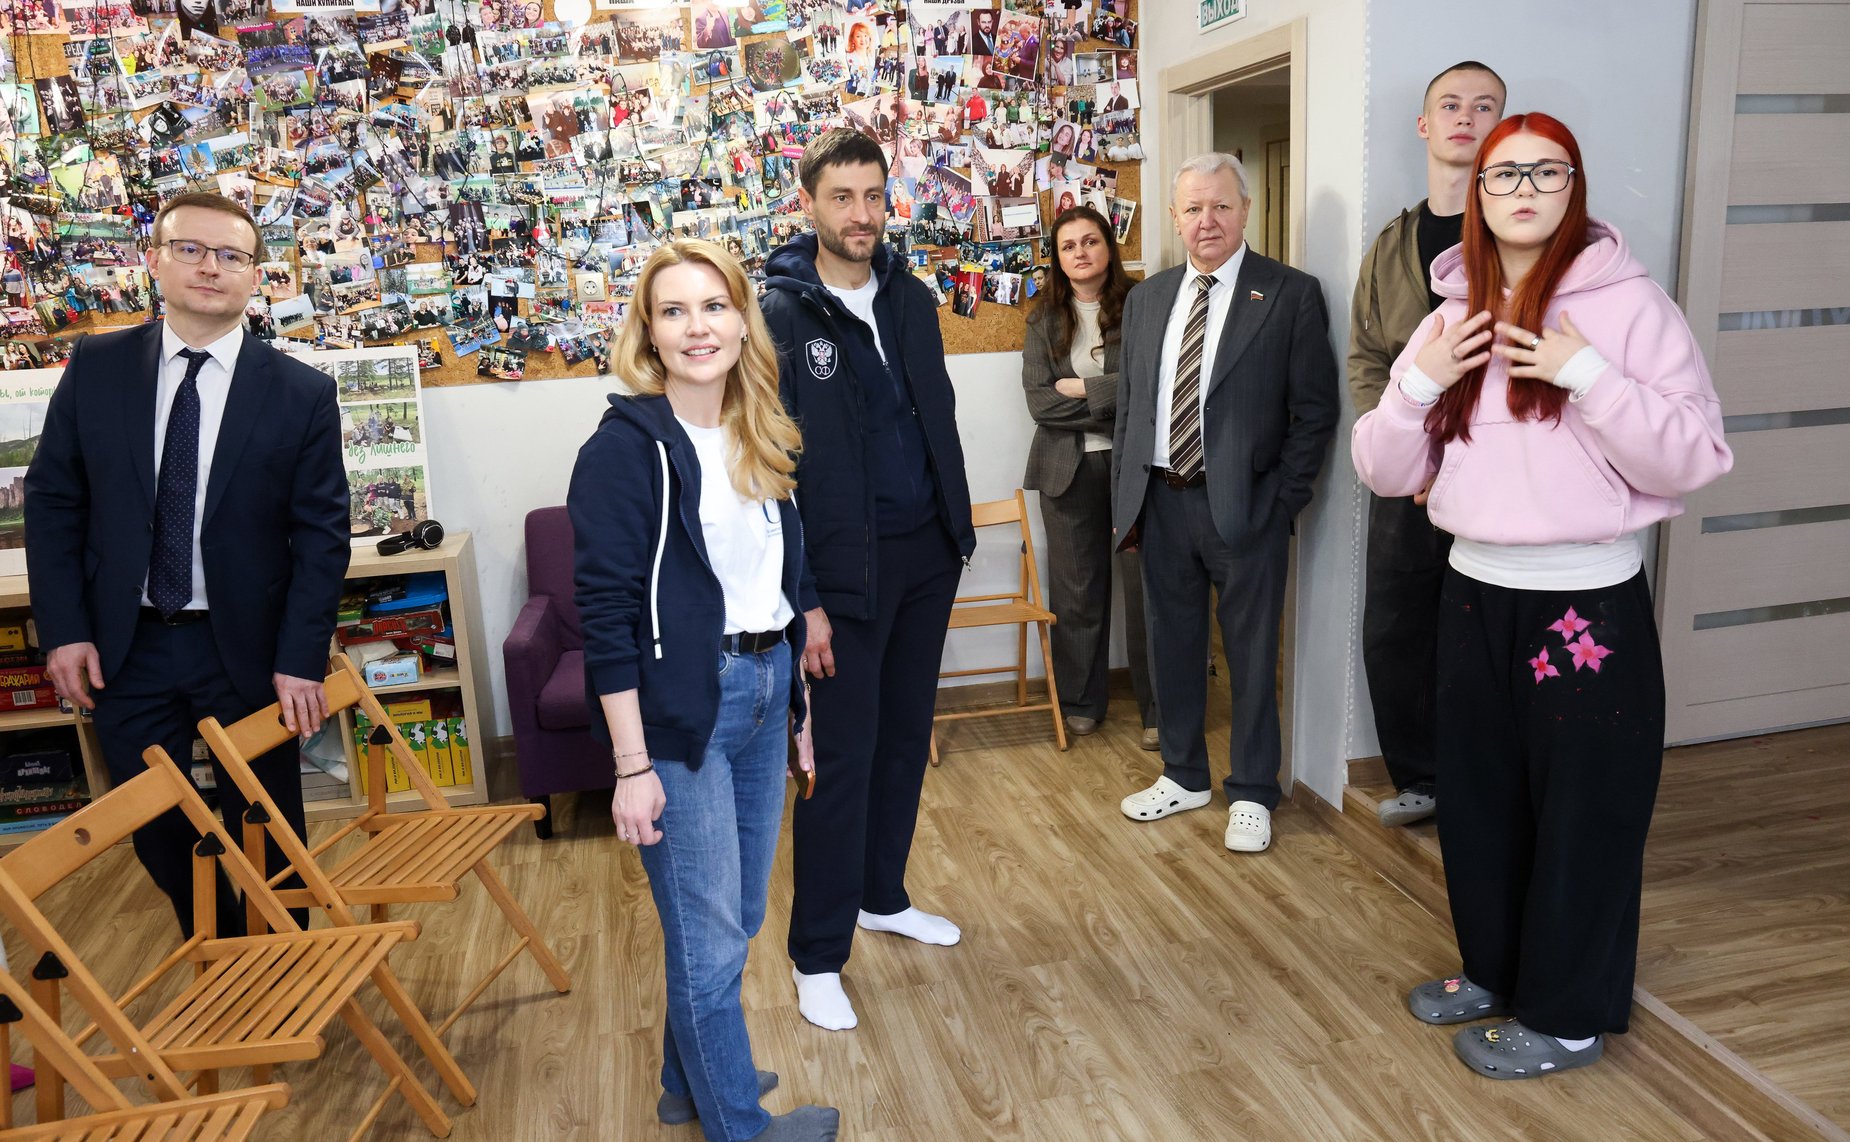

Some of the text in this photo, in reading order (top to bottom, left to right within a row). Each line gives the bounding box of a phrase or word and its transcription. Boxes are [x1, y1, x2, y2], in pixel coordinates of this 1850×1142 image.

[1202, 0, 1239, 25] ВЫХОД
[348, 440, 416, 464] без лишнего
[16, 802, 83, 815] СЛОВОДЕЛ
